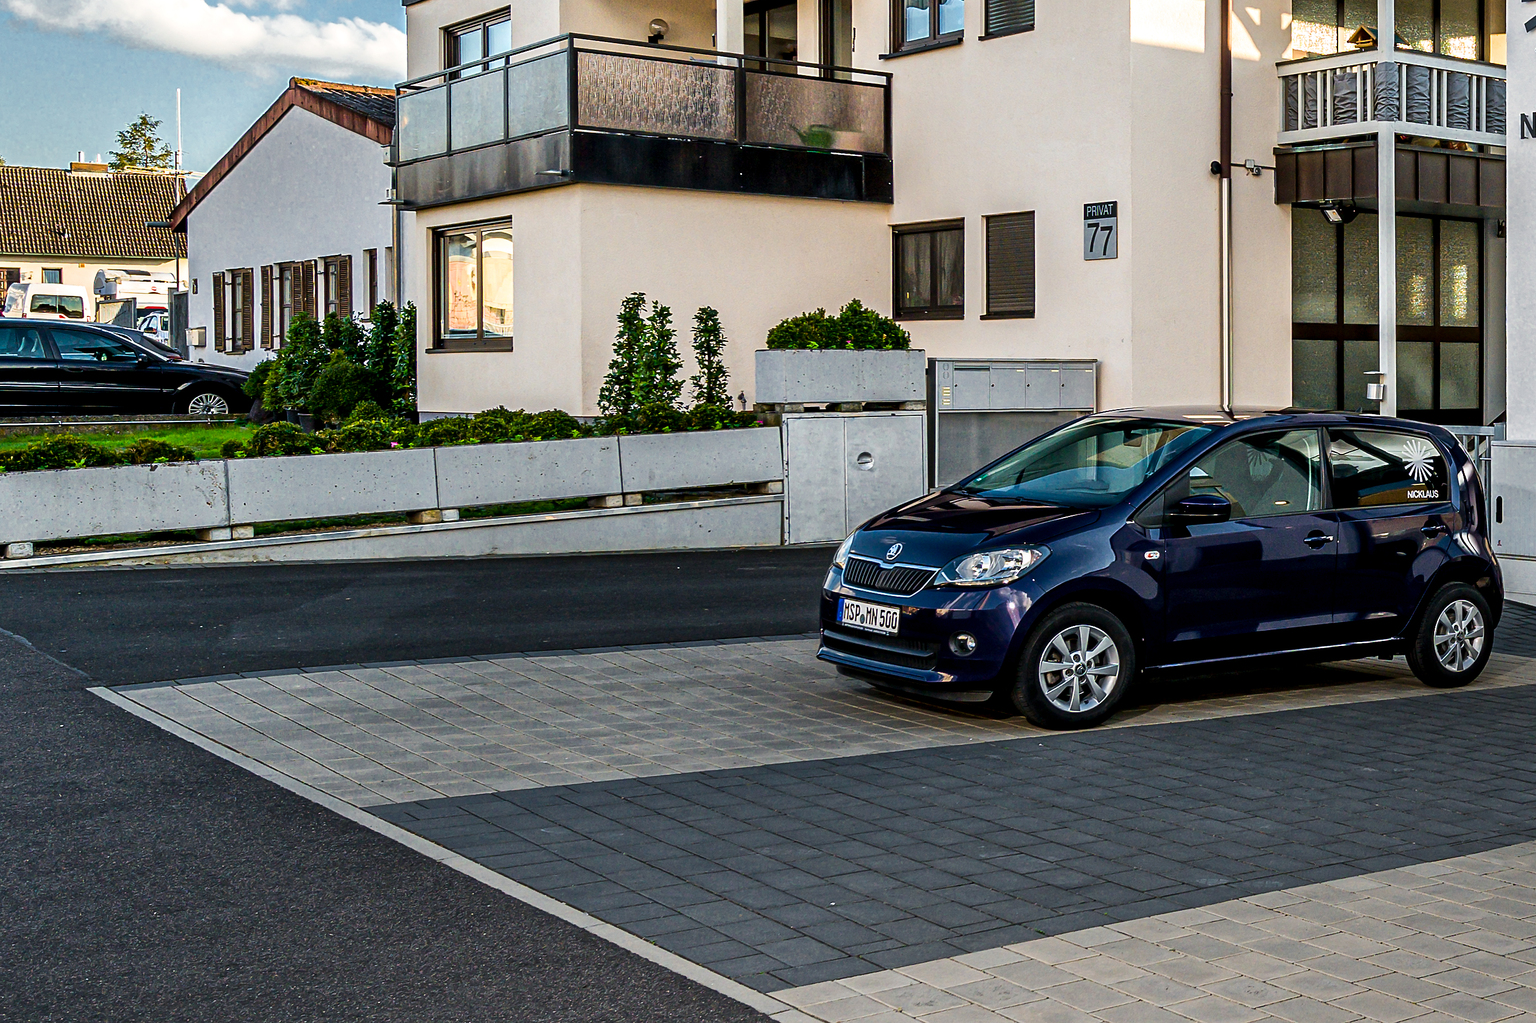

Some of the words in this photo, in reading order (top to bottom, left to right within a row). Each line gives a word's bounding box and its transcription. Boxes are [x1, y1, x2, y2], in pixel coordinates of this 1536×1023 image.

[1086, 203, 1114, 217] PRIVAT
[1087, 222, 1113, 256] 77
[1407, 489, 1439, 499] NICKLAUS
[879, 609, 898, 630] 500
